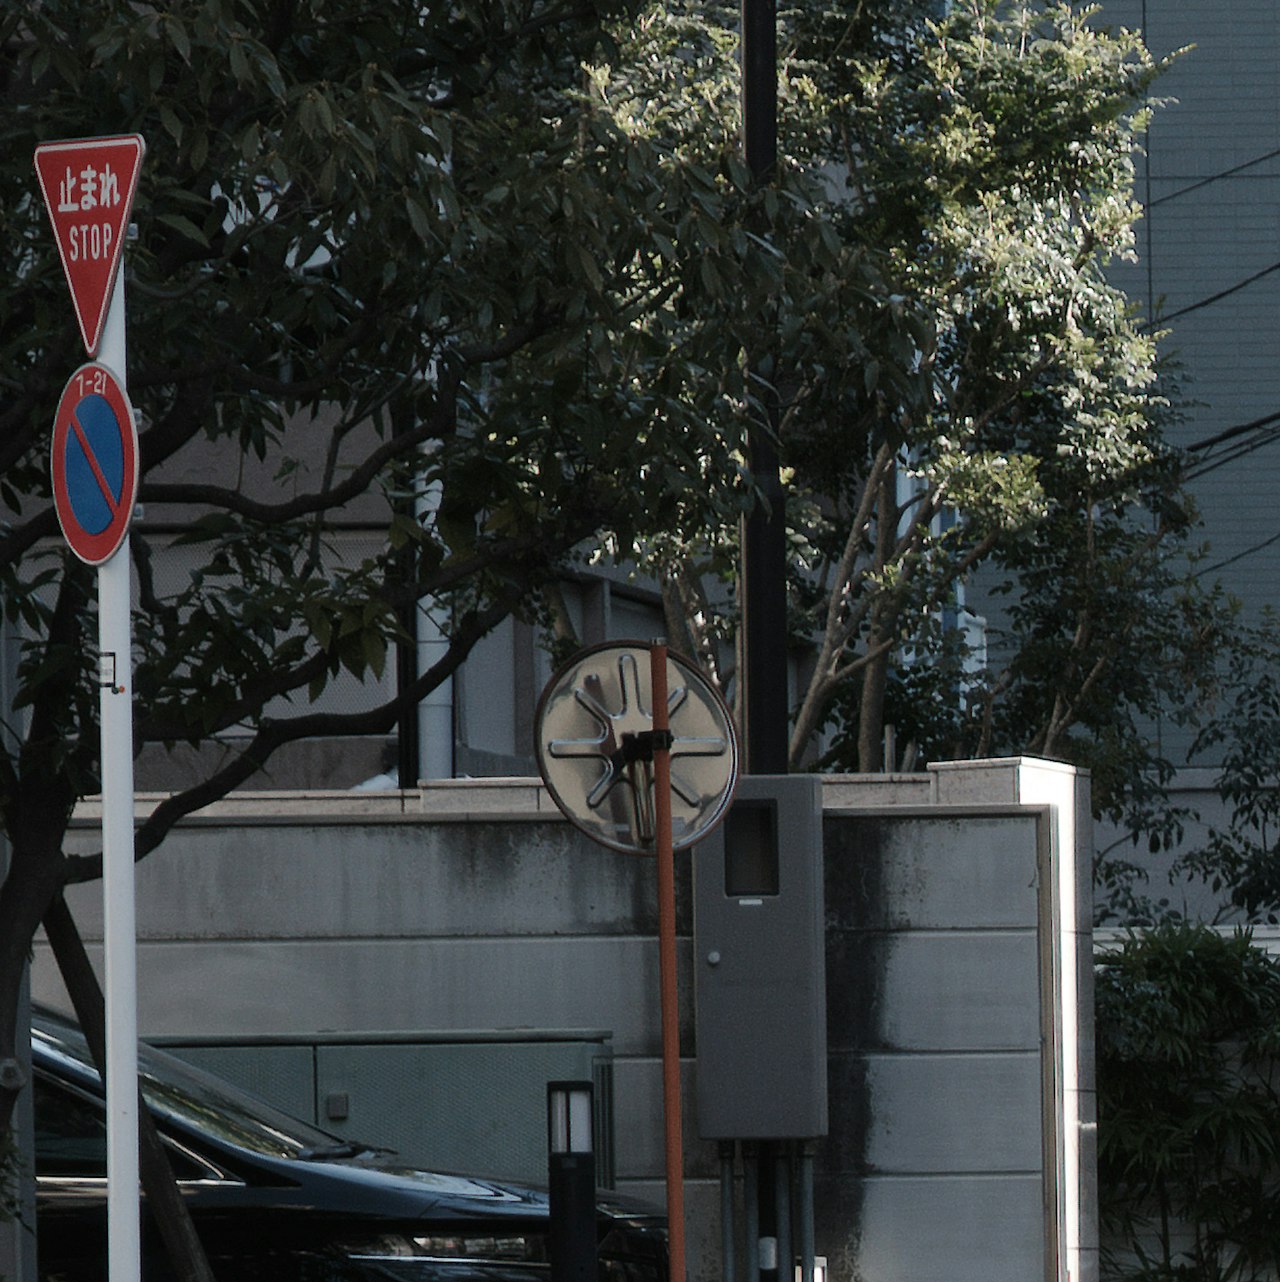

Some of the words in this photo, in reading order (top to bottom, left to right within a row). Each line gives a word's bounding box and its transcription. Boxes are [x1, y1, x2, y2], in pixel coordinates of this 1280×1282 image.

[58, 163, 121, 213] 止まれ
[69, 223, 113, 262] STOP
